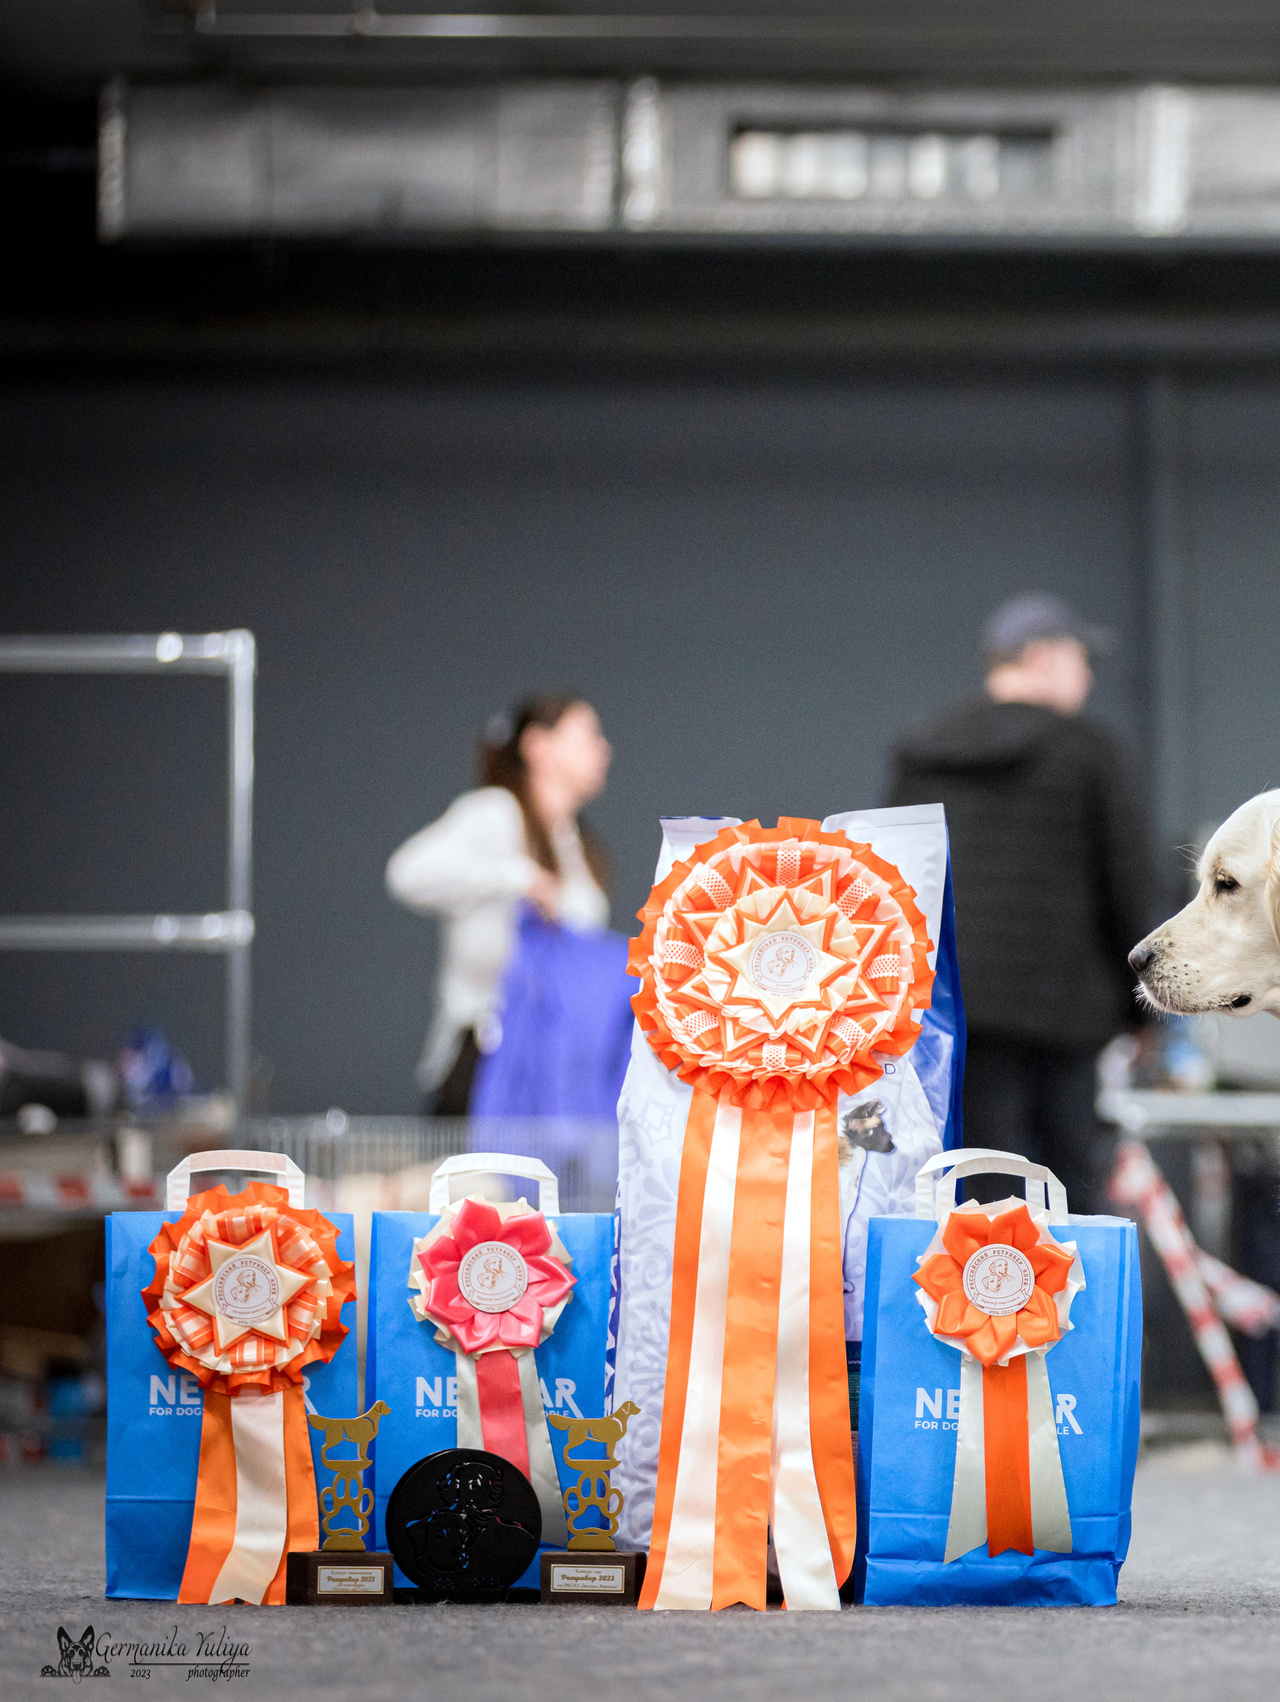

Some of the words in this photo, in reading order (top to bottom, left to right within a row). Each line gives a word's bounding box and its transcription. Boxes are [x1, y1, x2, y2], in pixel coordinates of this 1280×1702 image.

[781, 936, 810, 953] РЕТРИВЕР
[464, 1249, 483, 1287] РОССИЙСКИЙ
[486, 1247, 517, 1261] РЕТРИВЕР
[968, 1252, 989, 1290] РОССИЙСКИЙ
[992, 1249, 1023, 1265] РЕТРИВЕР
[217, 1263, 237, 1301] РОССИЙСКИЙ
[240, 1260, 271, 1275] РЕТРИВЕР
[149, 1407, 173, 1416] FOR
[176, 1407, 204, 1416] DOG
[416, 1409, 440, 1418] FOR
[914, 1420, 939, 1430] FOR
[327, 1575, 360, 1584] Ретривер
[561, 1574, 597, 1583] Ретривер
